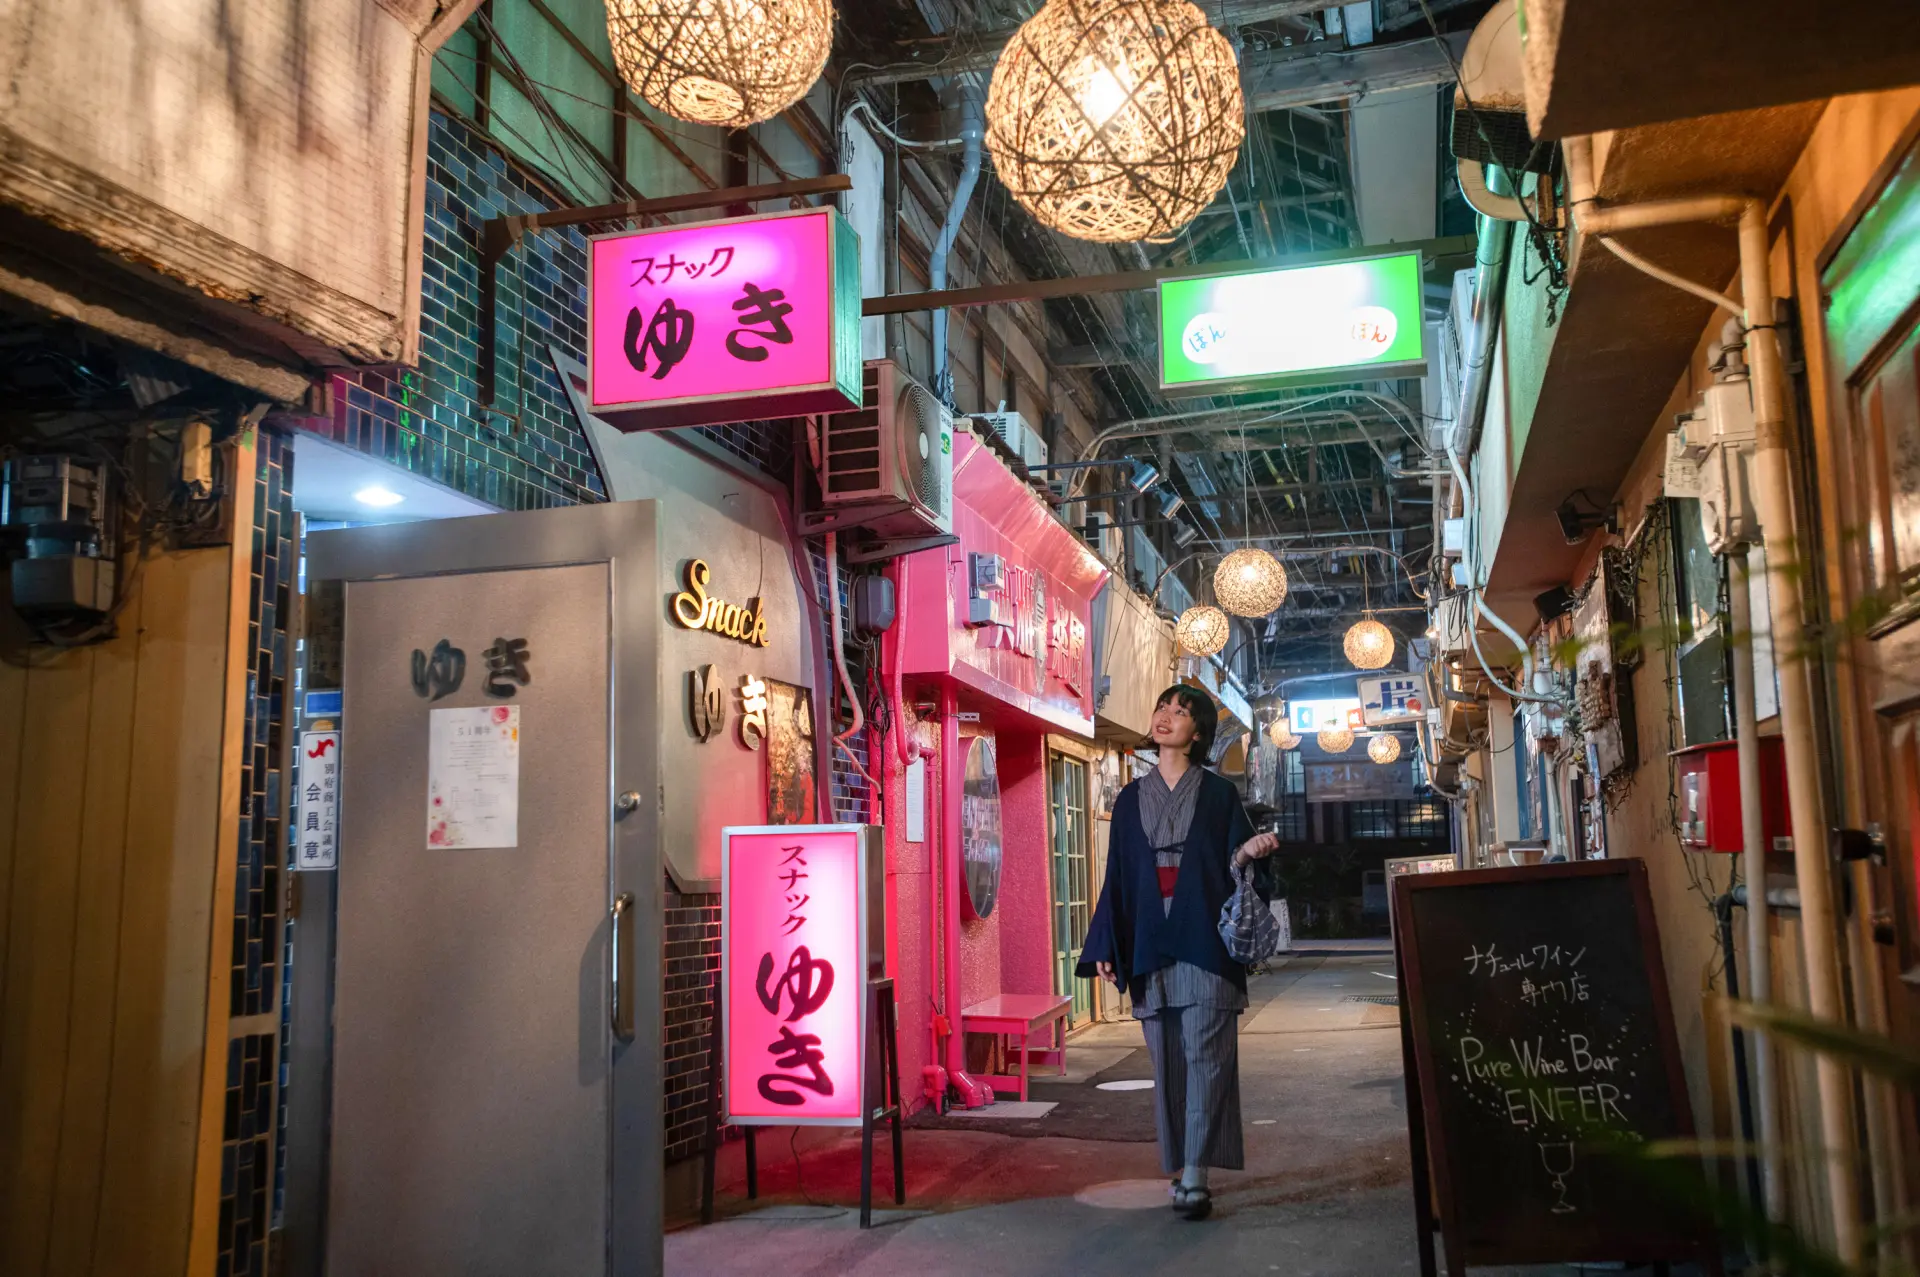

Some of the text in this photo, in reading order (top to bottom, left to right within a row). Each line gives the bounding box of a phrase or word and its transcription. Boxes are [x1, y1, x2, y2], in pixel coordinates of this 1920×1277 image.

[630, 246, 735, 288] スナック
[622, 281, 794, 381] ゆき
[672, 558, 771, 648] Snack
[411, 637, 531, 703] ゆき
[686, 662, 768, 751] ゆき
[304, 782, 321, 861] 会員章
[777, 844, 809, 937] スナック
[1463, 942, 1588, 979] ナチュールワイン
[1520, 971, 1590, 1007] 専門店
[755, 944, 835, 1106] ゆき
[1459, 1033, 1621, 1084] Pure Wine Bar
[1504, 1083, 1628, 1126] ENFER
